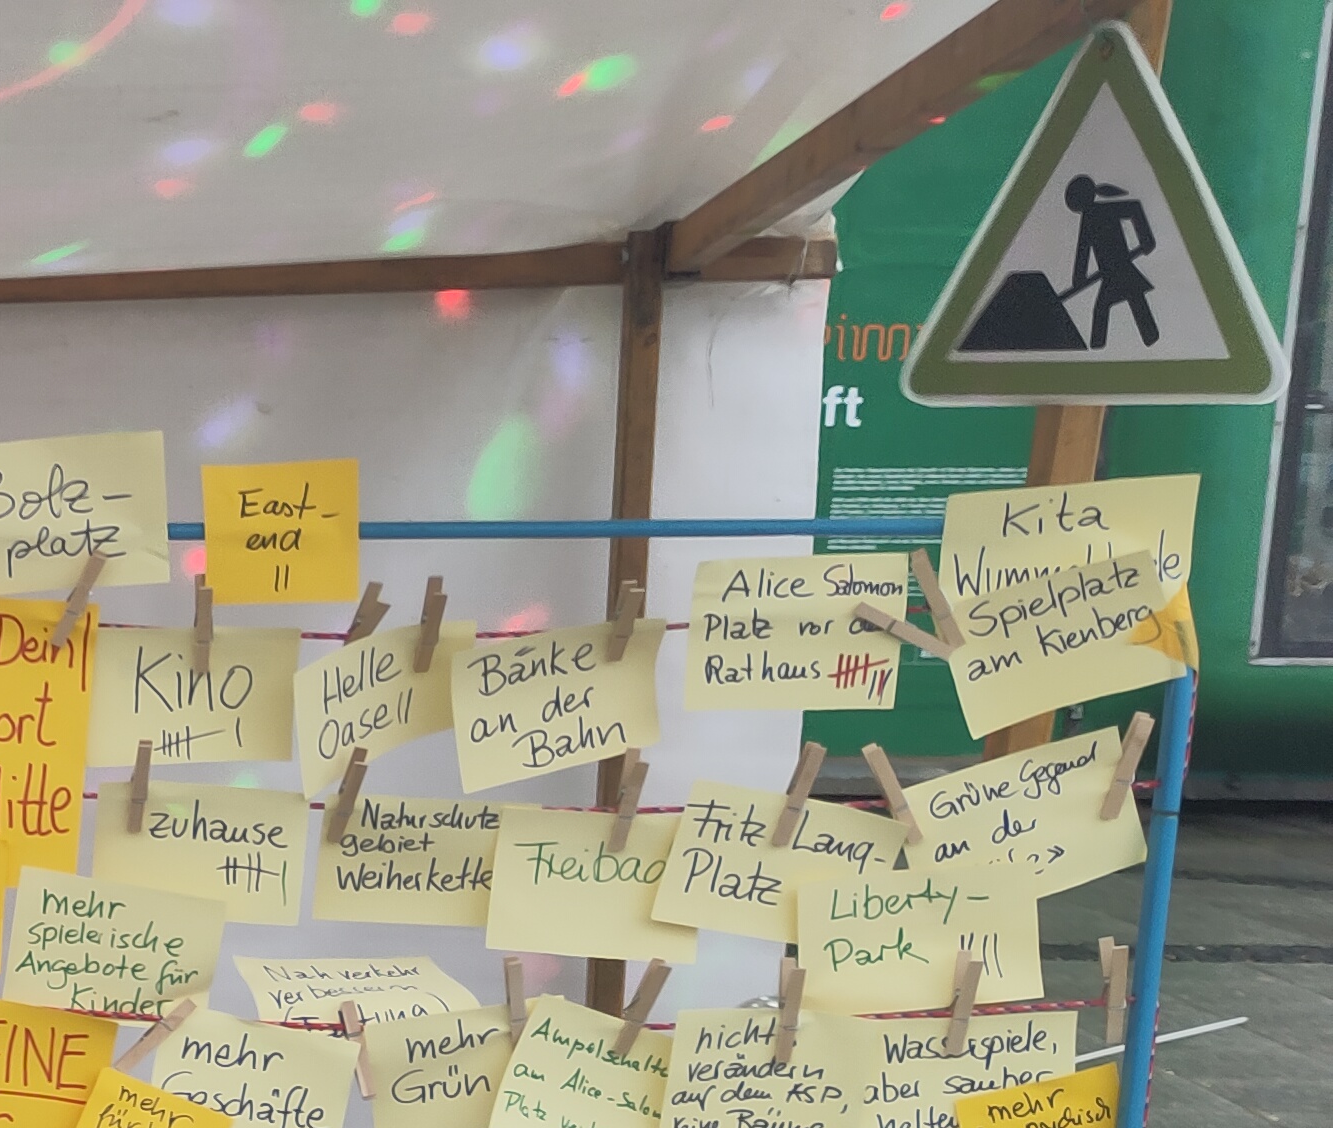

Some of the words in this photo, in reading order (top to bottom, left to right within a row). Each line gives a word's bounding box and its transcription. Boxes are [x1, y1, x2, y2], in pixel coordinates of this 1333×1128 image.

[1002, 491, 1110, 537] Kita
[5, 524, 129, 578] platz
[722, 568, 819, 603] Alice
[968, 562, 1140, 638] Spielplatz
[703, 607, 774, 641] Platz
[134, 645, 253, 713] Kino
[322, 646, 402, 715] Helle
[468, 640, 597, 696] Bänke
[705, 649, 821, 685] Rathaus
[967, 651, 1023, 682] am
[470, 712, 519, 744] an
[540, 684, 595, 725] der
[512, 720, 627, 769] Bahn
[929, 780, 1020, 820] Grüne
[1018, 740, 1098, 800] Gegend
[148, 799, 289, 849] zuhause
[339, 831, 436, 858] gebiet
[686, 797, 767, 847] Fritz
[934, 839, 971, 863] an
[682, 846, 783, 907] Platz
[42, 889, 127, 920] mehr
[830, 877, 991, 924] Liberty-
[14, 950, 148, 992] Angebote
[155, 952, 200, 994] für
[823, 926, 930, 973] Park
[180, 1031, 286, 1074] mehr
[405, 1021, 501, 1064] mehr
[390, 1062, 492, 1106] Grün
[863, 1071, 921, 1105] aber
[986, 1088, 1065, 1124] mehr
